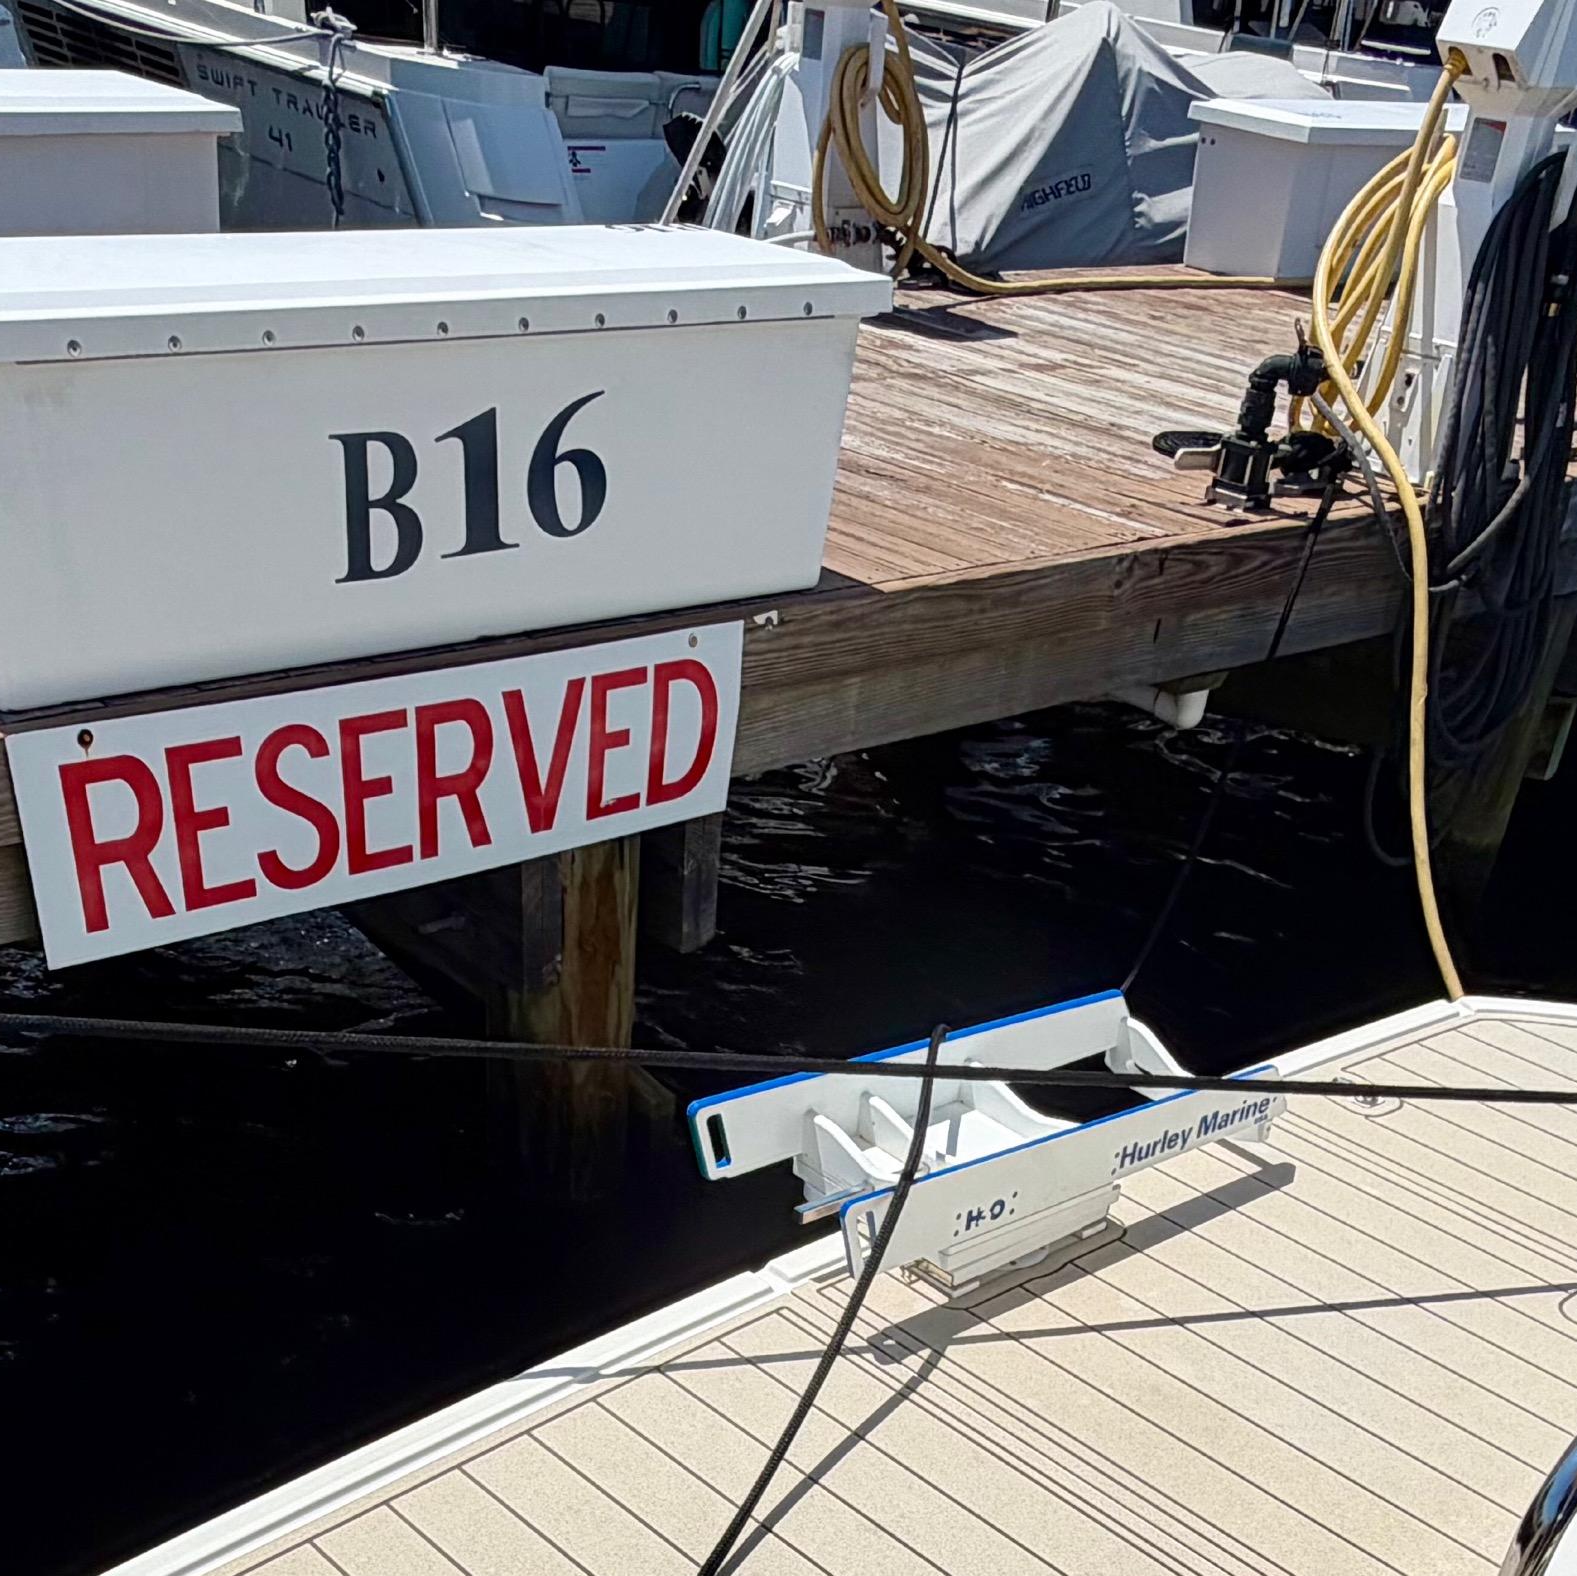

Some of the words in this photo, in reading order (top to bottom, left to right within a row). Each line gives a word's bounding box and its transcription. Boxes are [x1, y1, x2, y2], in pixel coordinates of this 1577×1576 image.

[196, 63, 258, 97] SWIFT
[267, 125, 293, 152] 41
[327, 389, 608, 585] B16
[58, 657, 720, 935] RESERVED
[1118, 1124, 1194, 1170] Hurley
[1196, 1097, 1271, 1139] Marine
